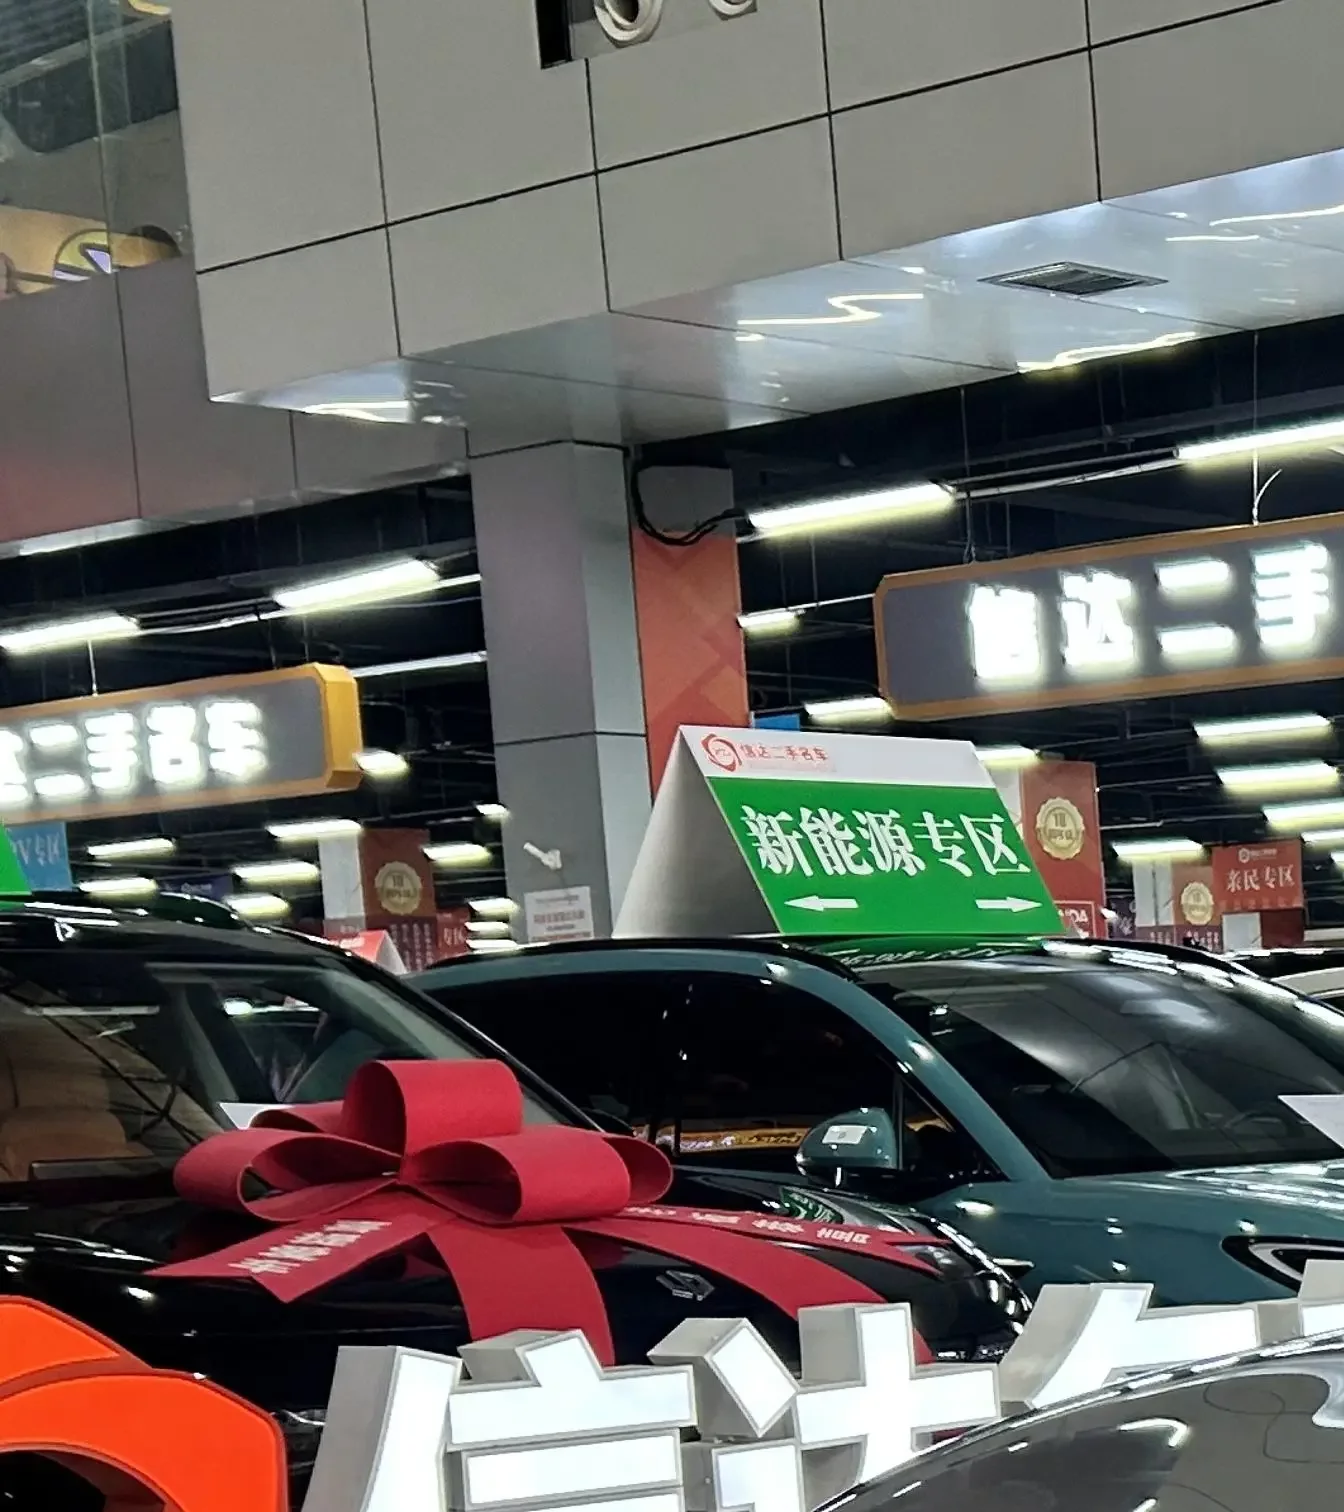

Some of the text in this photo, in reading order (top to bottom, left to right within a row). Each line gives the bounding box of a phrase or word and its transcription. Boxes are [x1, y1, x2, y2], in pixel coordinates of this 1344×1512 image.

[740, 803, 1032, 877] 新能源专区
